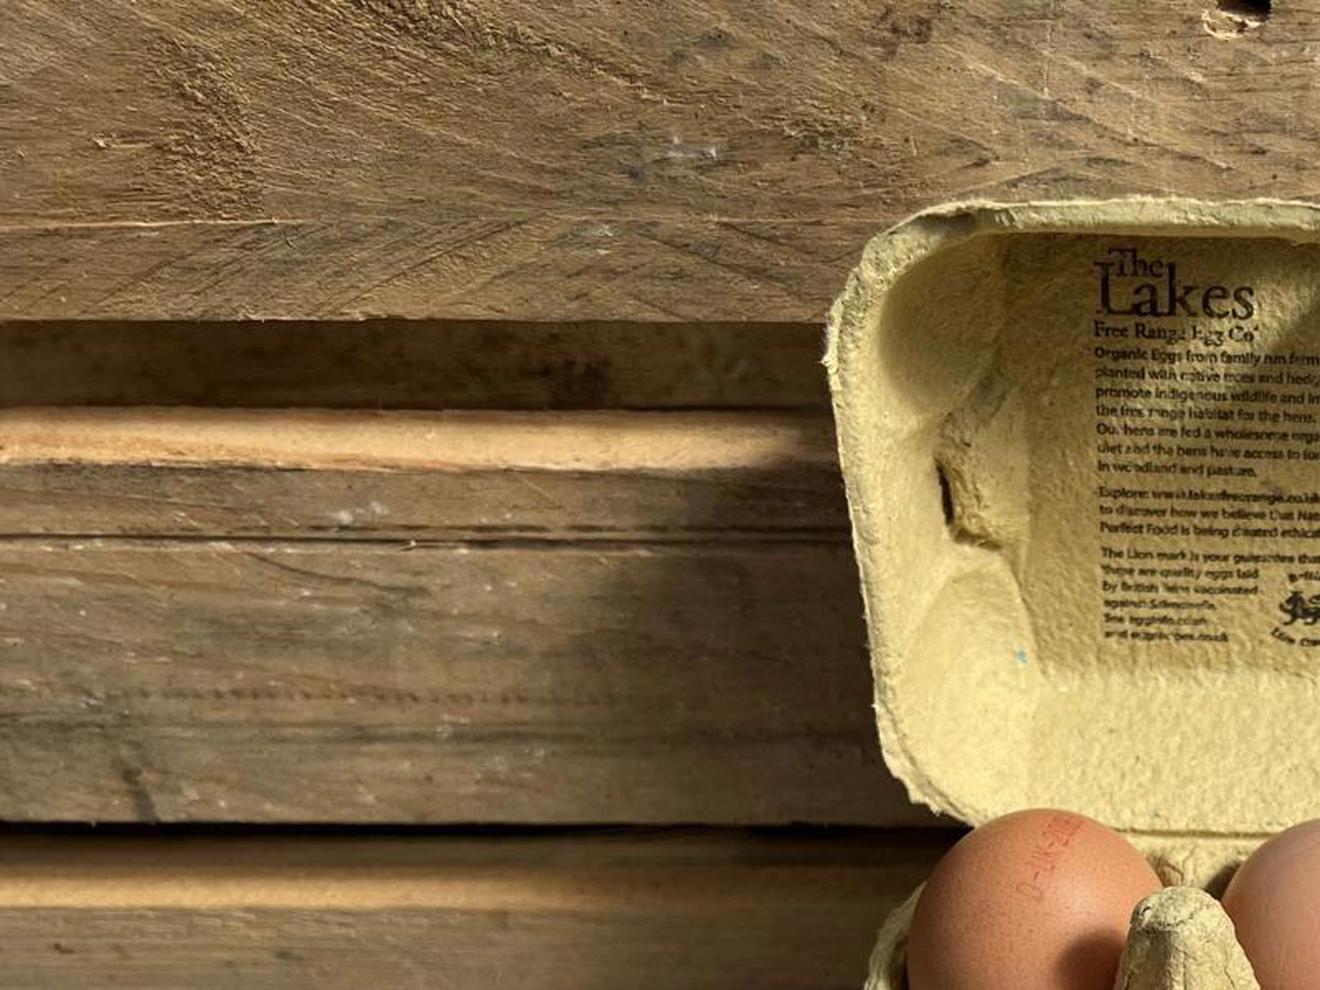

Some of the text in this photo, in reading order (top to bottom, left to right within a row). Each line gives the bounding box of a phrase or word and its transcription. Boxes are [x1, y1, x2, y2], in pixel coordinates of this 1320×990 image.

[1108, 247, 1166, 278] The
[1093, 262, 1255, 321] Lakes
[1093, 321, 1129, 340] Free
[1134, 322, 1187, 342] Range
[1094, 347, 1148, 363] Organic
[1151, 348, 1181, 364] Eggs
[1186, 348, 1217, 363] from
[1220, 349, 1261, 367] family
[1095, 367, 1145, 383] planted
[1148, 367, 1177, 381] with
[1258, 372, 1283, 385] and
[1096, 388, 1151, 403] promote
[1280, 391, 1305, 405] and
[1096, 404, 1117, 417] the
[1259, 409, 1280, 423] the
